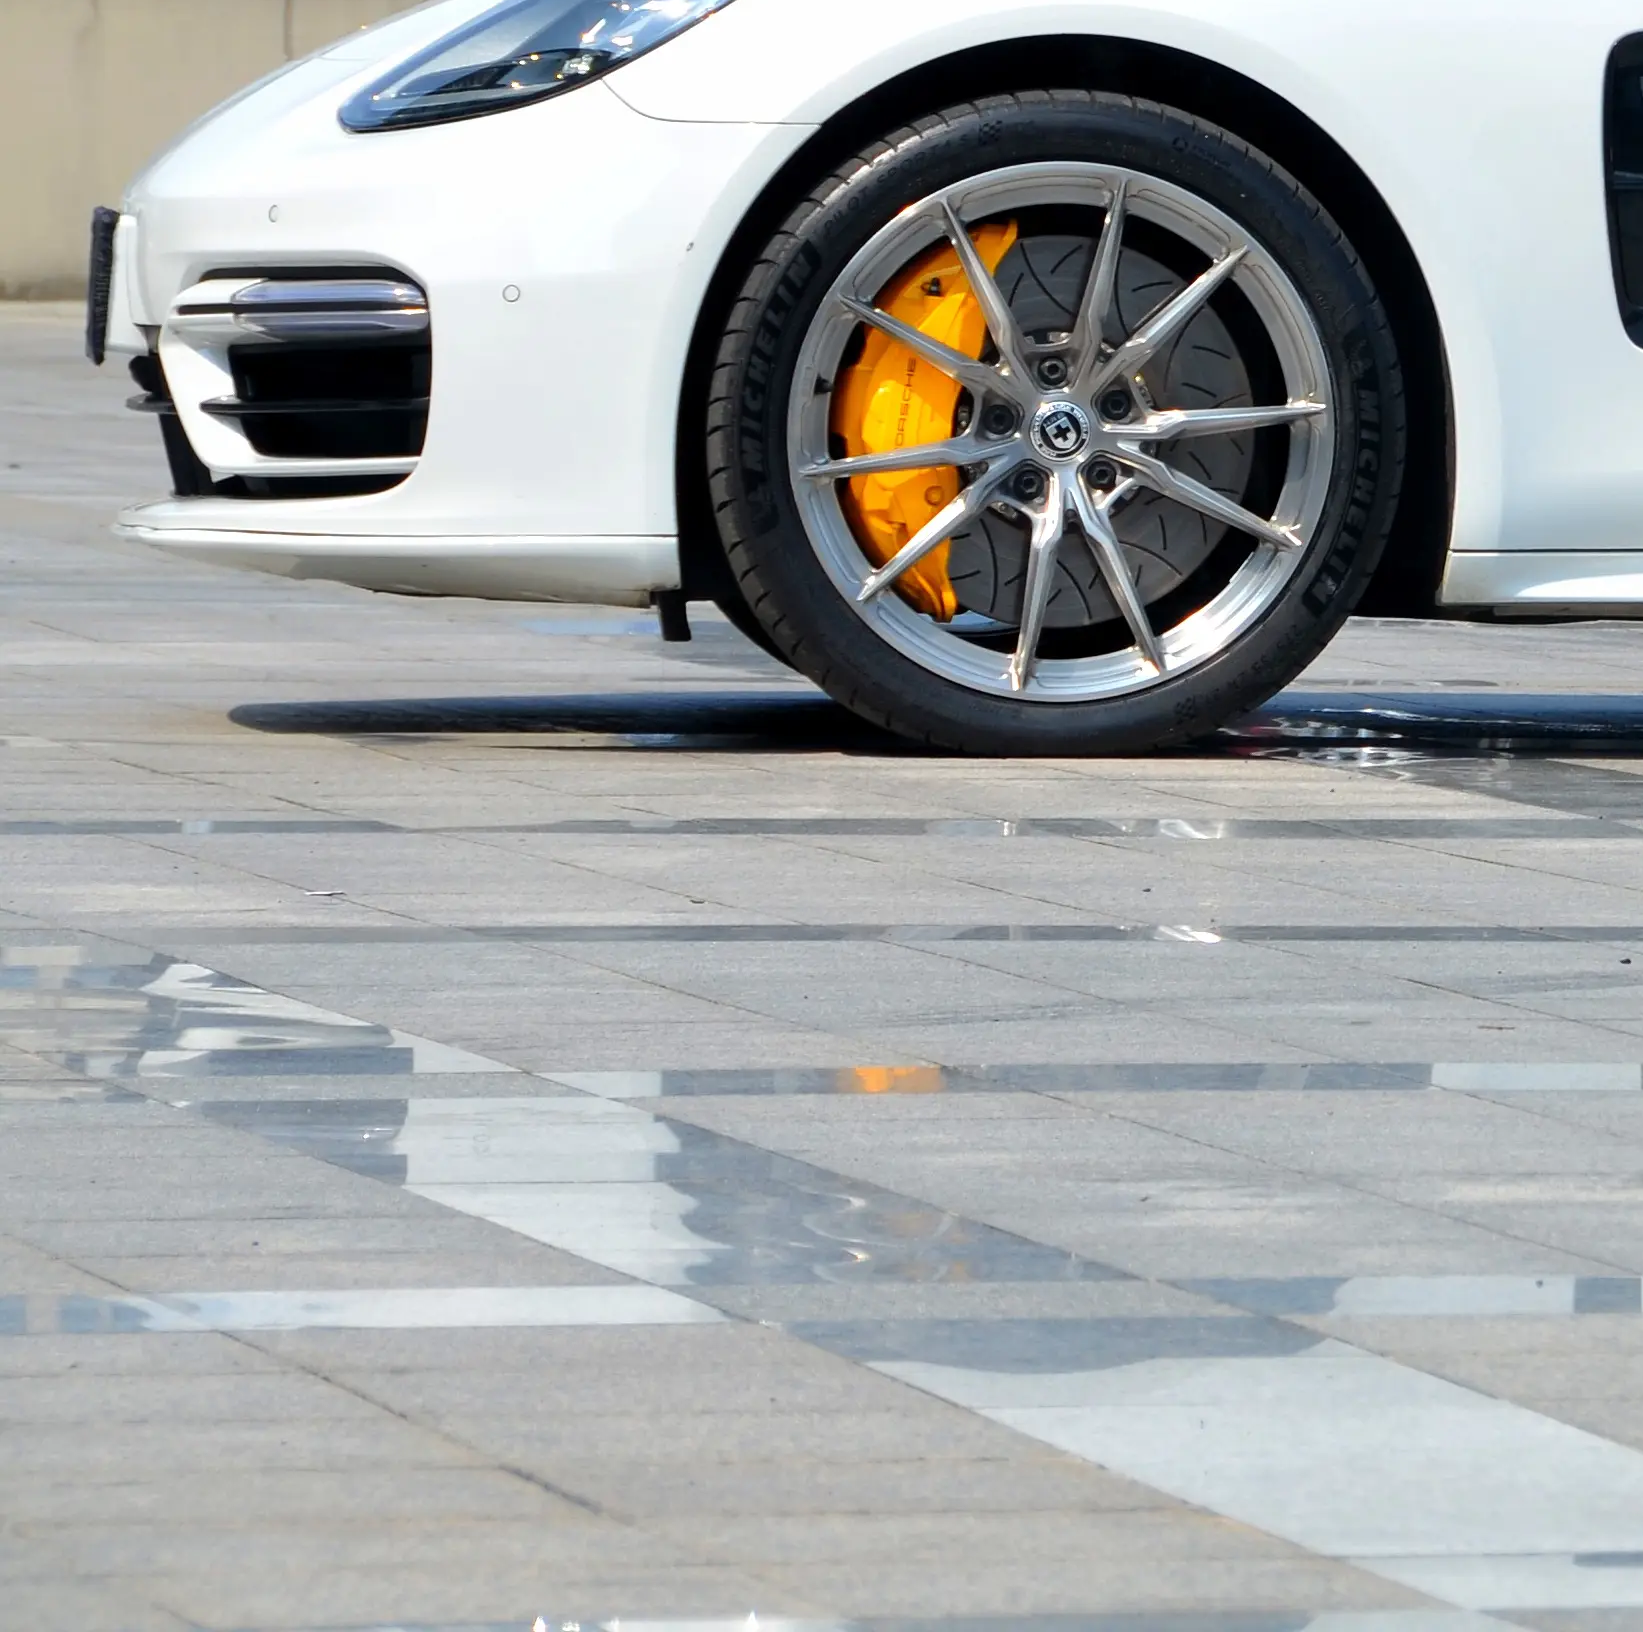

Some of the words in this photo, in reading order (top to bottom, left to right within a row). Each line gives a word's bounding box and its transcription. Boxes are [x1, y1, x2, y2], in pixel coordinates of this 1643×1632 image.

[742, 249, 816, 471] MICHELIN
[894, 357, 917, 447] ORSCHE
[1311, 387, 1380, 605] MICHELIN
